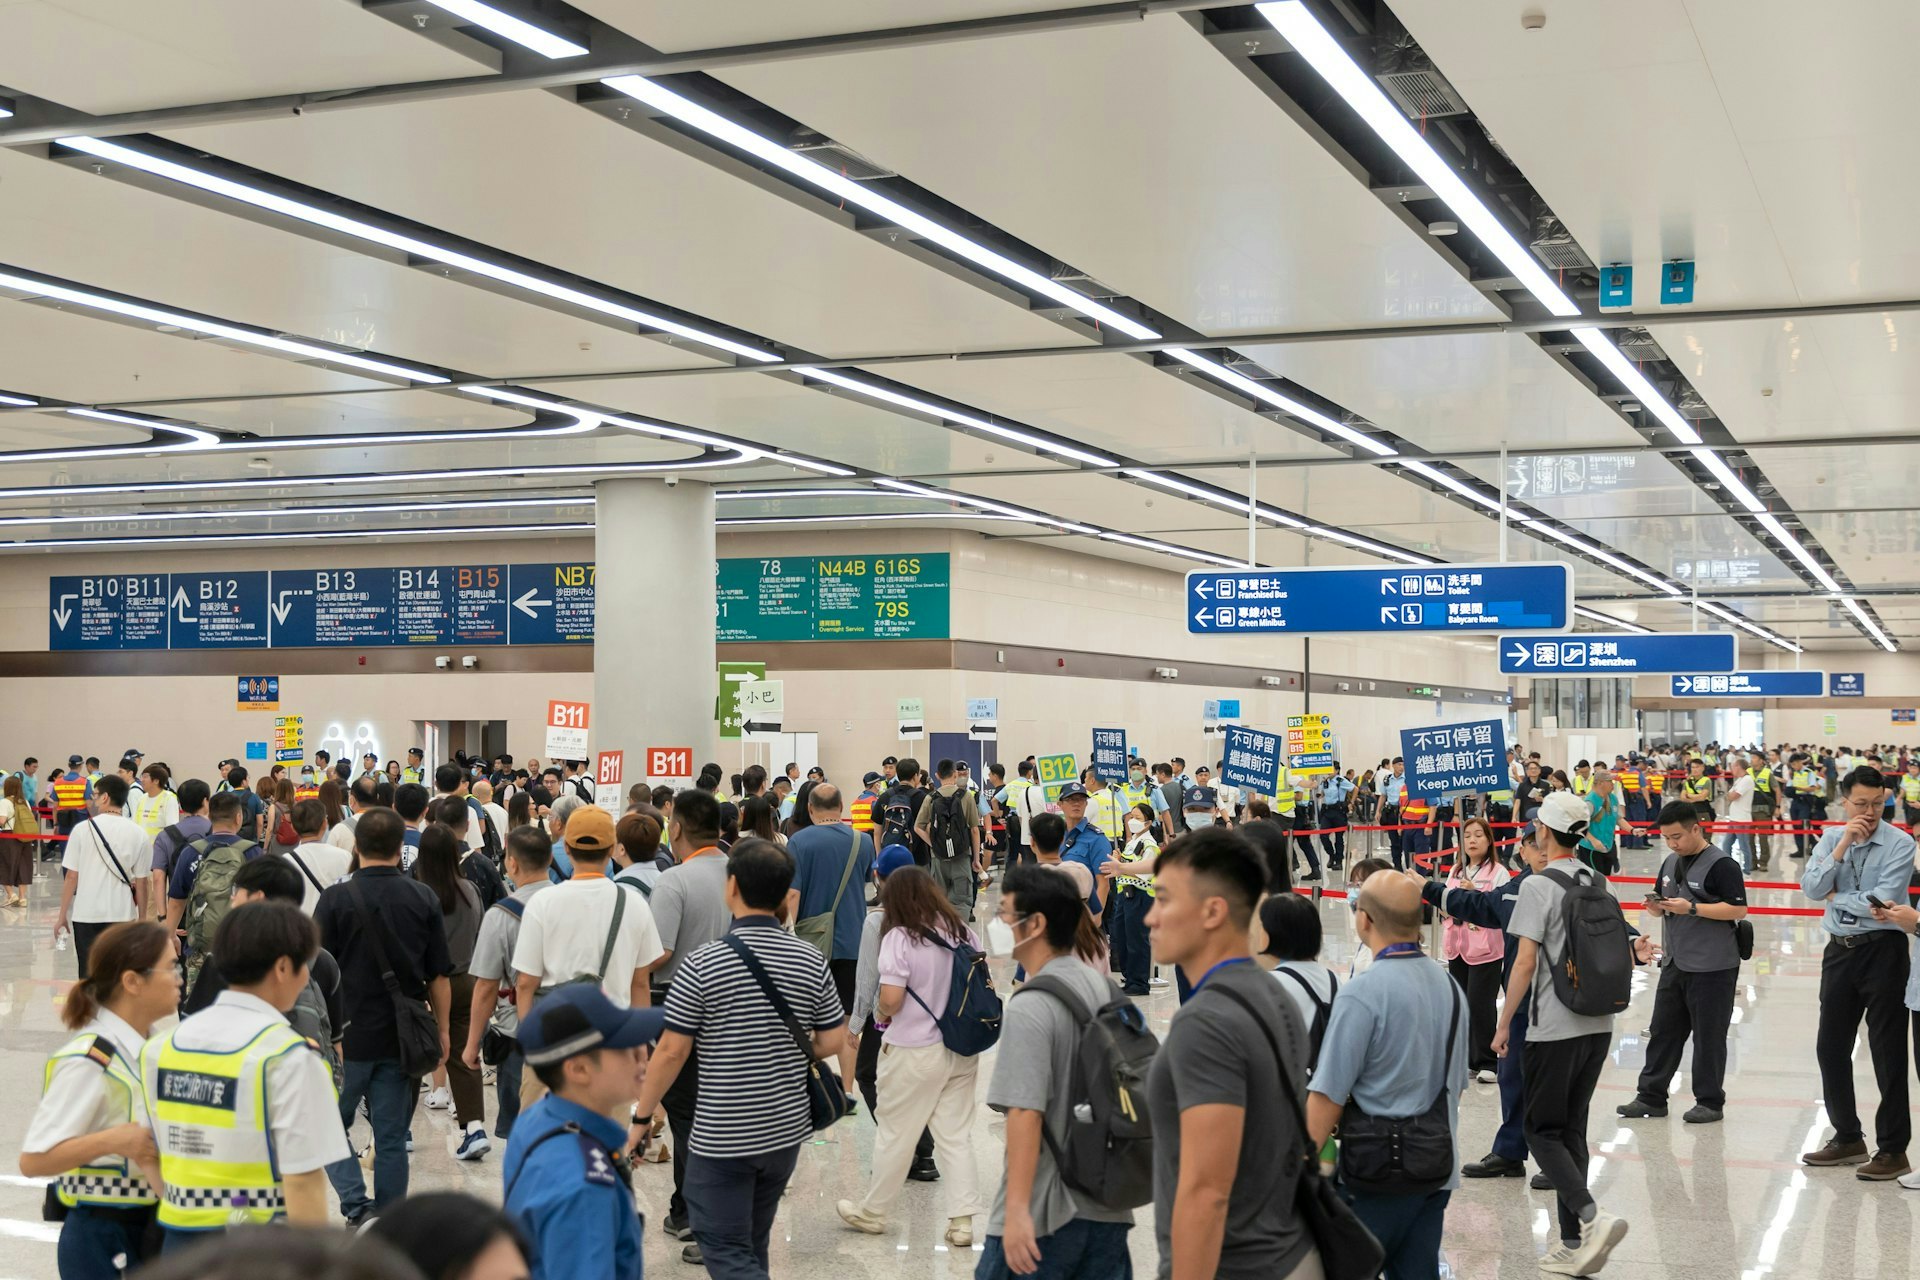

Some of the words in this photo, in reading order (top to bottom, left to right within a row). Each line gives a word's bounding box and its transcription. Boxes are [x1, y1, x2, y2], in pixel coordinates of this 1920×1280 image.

[760, 560, 781, 575] 78
[820, 560, 866, 576] N44B
[875, 559, 921, 575] 616S
[316, 571, 356, 591] B13
[400, 570, 440, 589] B14
[459, 568, 500, 588] B15
[1238, 578, 1281, 591] 專營巴士
[1447, 574, 1483, 587] 洗手間
[83, 579, 119, 597] B10
[127, 578, 160, 597] B11
[200, 580, 238, 599] B12
[556, 588, 594, 596] 沙田市中心
[1238, 590, 1274, 599] Franchised
[1275, 590, 1287, 599] Bus
[1447, 587, 1470, 595] Toilet
[875, 602, 909, 617] 79S
[1238, 606, 1282, 618] 專線小巴
[1448, 603, 1483, 615] 育嬰間
[1238, 618, 1258, 627] Green
[1259, 618, 1286, 627] Minibus
[1448, 615, 1479, 626] Babycare
[1479, 615, 1498, 624] Room
[1589, 642, 1618, 656] 深圳
[1589, 657, 1637, 666] Shenzhen
[746, 691, 775, 704] 小巴
[553, 704, 584, 727] B11
[1288, 718, 1302, 727] B13
[1095, 731, 1122, 747] 不可停留
[1231, 729, 1275, 754] 不可停留
[1289, 731, 1303, 740] B14
[1412, 725, 1492, 751] 不可停留
[1290, 743, 1304, 752] B15
[653, 751, 686, 775] B11
[1096, 749, 1123, 765] 繼續前行
[1228, 749, 1273, 774] 繼續前行
[1415, 749, 1495, 775] 繼續前行
[600, 755, 621, 783] B11
[1040, 756, 1077, 780] B12
[1098, 767, 1108, 776] Keep
[1109, 767, 1125, 778] Moving
[1227, 768, 1245, 783] Keep
[1246, 773, 1271, 790] Moving
[1417, 779, 1449, 791] Keep
[1452, 773, 1498, 788] Moving
[172, 1074, 215, 1102] SECURITY
[212, 1081, 225, 1104] 安
